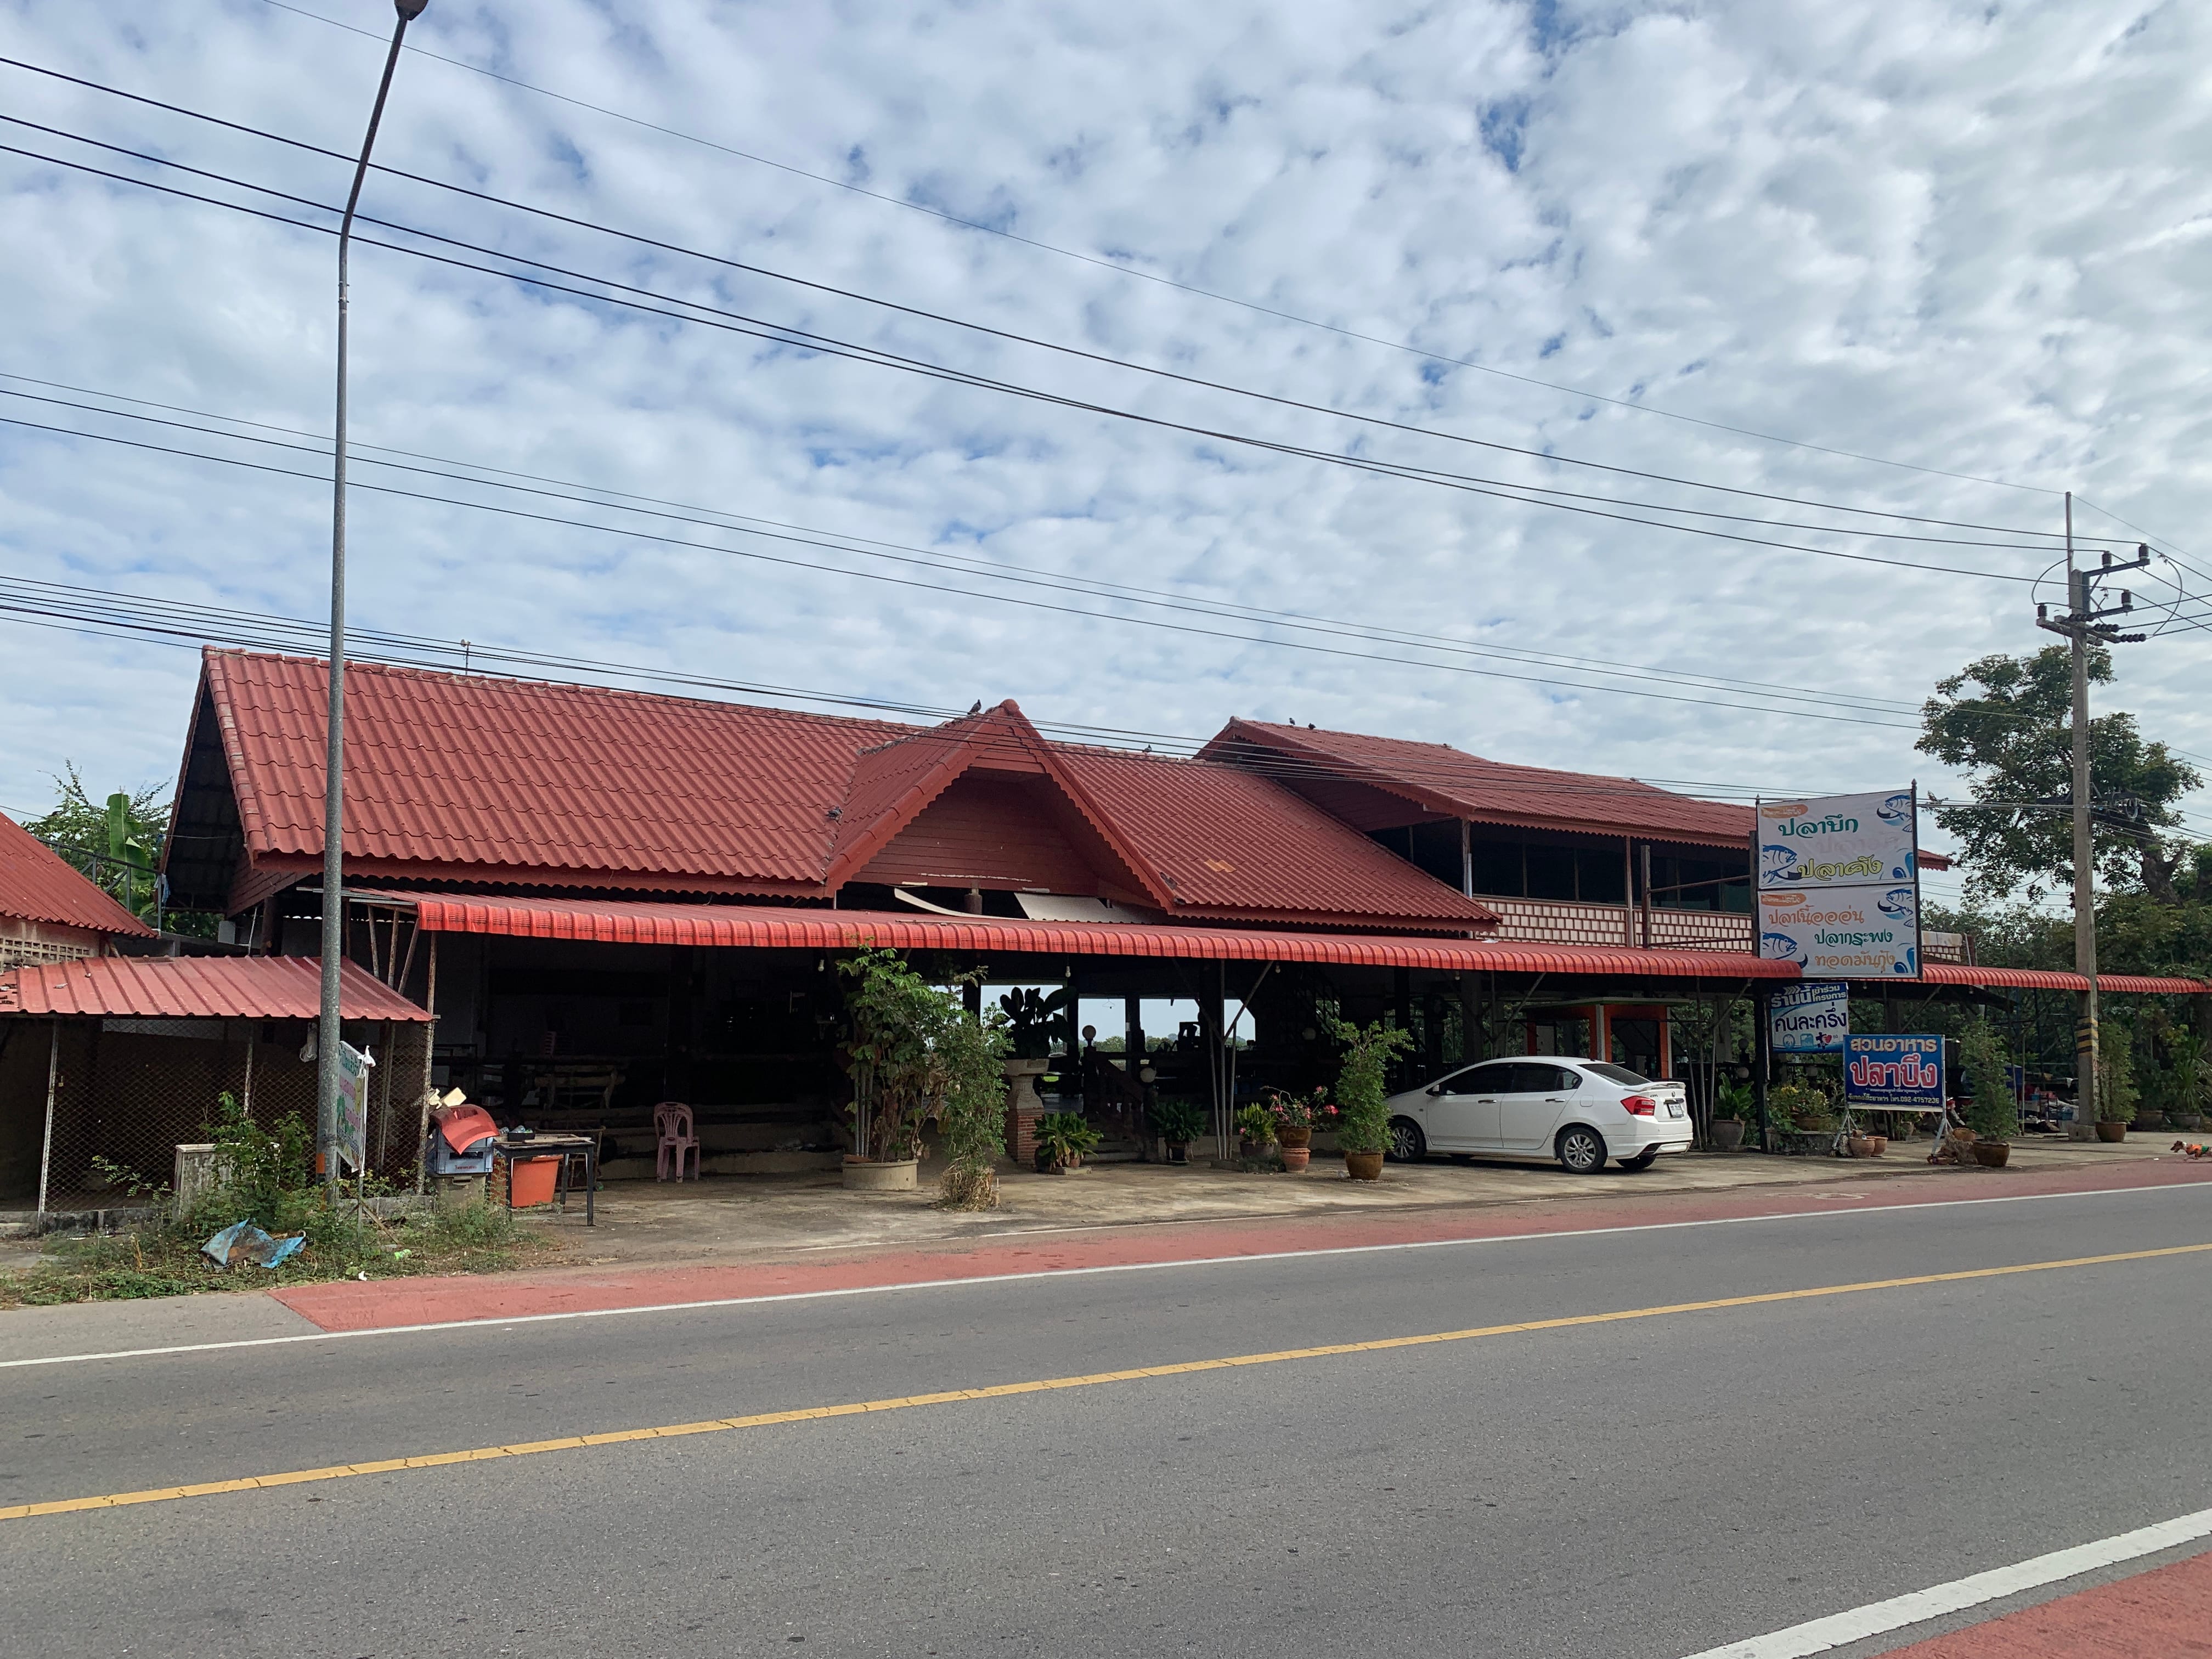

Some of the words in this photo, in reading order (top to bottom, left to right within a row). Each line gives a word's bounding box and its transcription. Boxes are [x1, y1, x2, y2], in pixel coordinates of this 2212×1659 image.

[1778, 814, 1859, 838] ปลาบึก
[1814, 928, 1893, 947] ปลากระพง
[1815, 950, 1896, 973] ทอดมันกุ้ง
[1771, 985, 1812, 1007] ร้านนี้
[1812, 985, 1841, 996] เข้าร่วม
[1812, 991, 1847, 1002] โครงการ
[1775, 1001, 1847, 1032] คนละครึ่ง
[1850, 1037, 1938, 1053] สวนอาหาร
[1849, 1052, 1938, 1088] ปลาบึง
